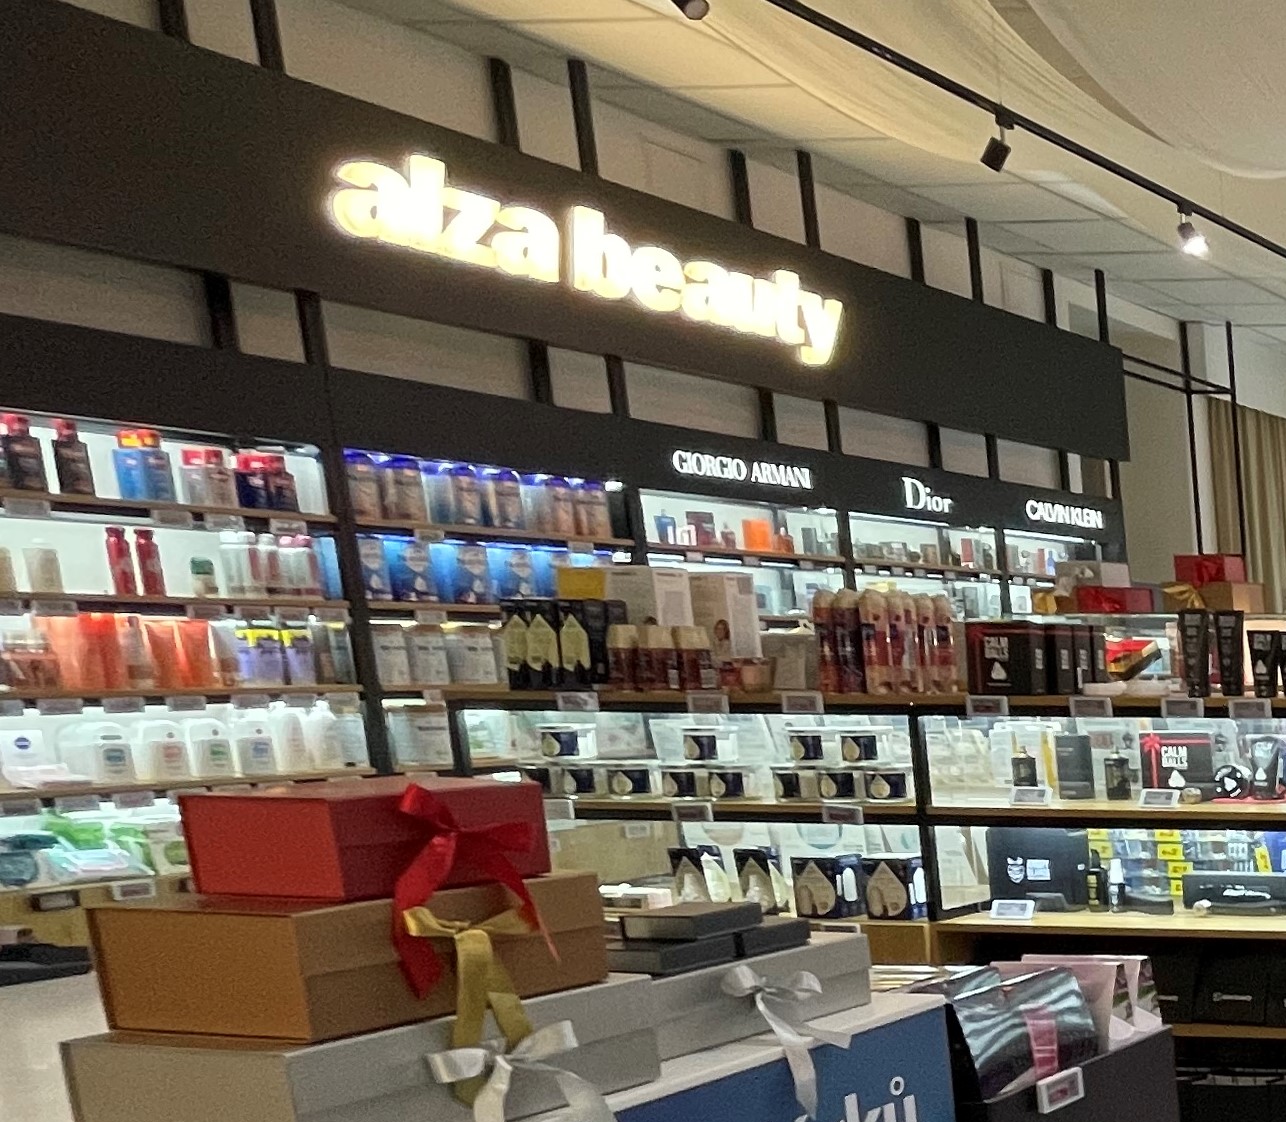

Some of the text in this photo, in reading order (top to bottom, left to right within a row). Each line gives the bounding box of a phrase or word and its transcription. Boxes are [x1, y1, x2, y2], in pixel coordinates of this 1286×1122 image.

[332, 153, 844, 366] alza beauty
[672, 450, 812, 490] GIORGIO ARMANI
[902, 476, 952, 514] Dior
